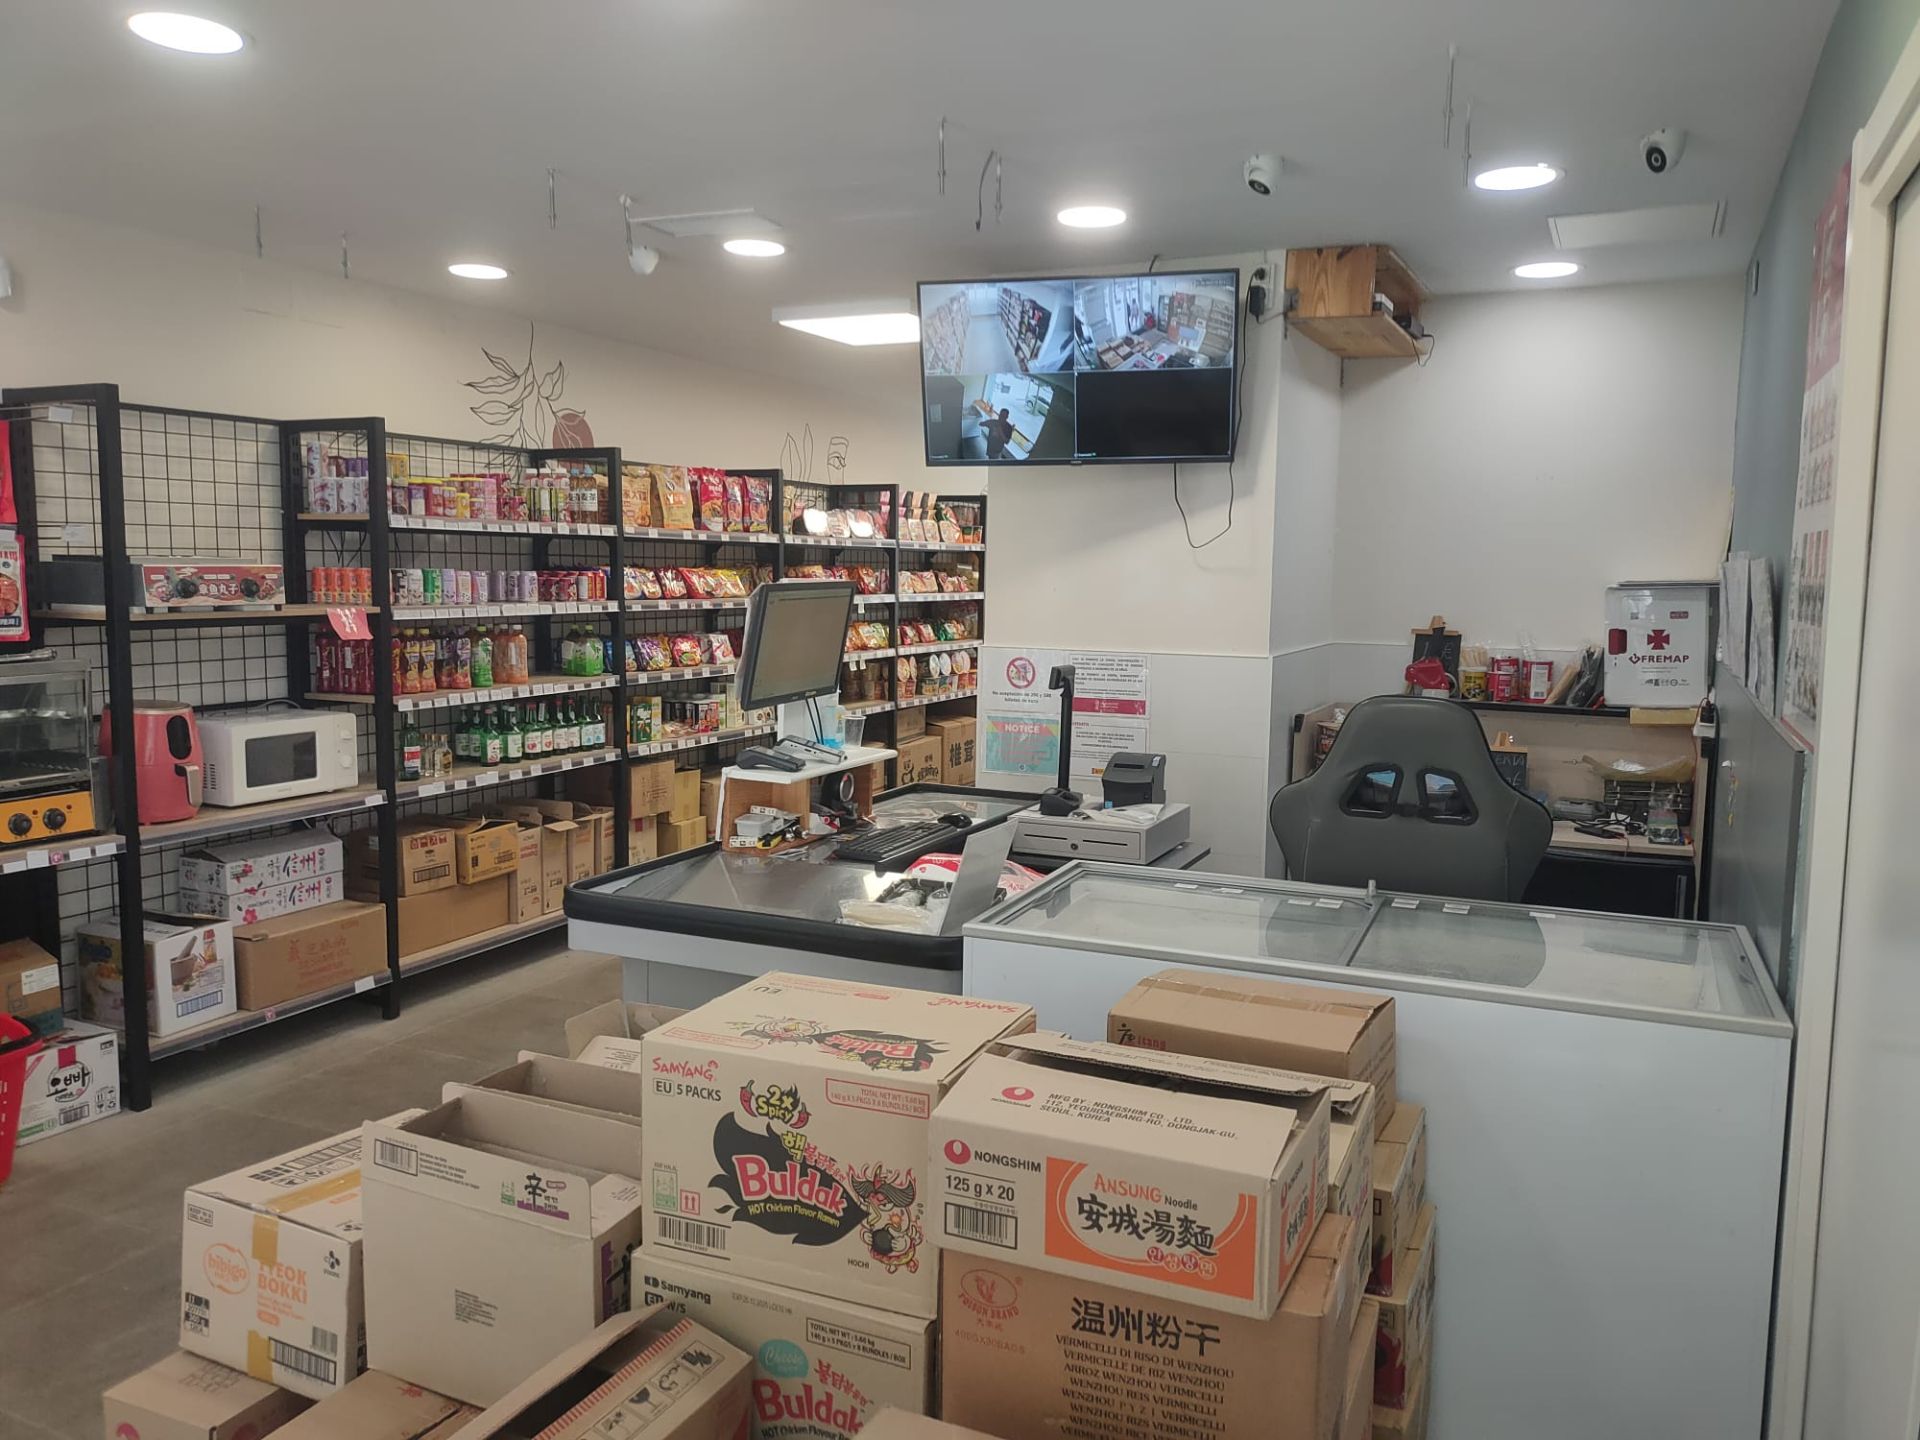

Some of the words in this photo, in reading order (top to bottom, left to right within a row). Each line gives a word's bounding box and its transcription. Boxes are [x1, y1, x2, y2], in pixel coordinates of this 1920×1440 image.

[1641, 655, 1690, 663] FREMAP
[1004, 723, 1041, 734] NOTICE
[46, 1065, 91, 1098] 오빠
[652, 1057, 719, 1082] SAMYANG
[655, 1081, 672, 1096] EU
[676, 1084, 684, 1098] 5
[685, 1085, 722, 1102] PACKS
[1048, 1092, 1071, 1103] MFG
[1093, 1101, 1149, 1117] NONGSHIM
[755, 1095, 794, 1125] Spicy
[1076, 1111, 1111, 1124] KOREA
[782, 1130, 807, 1163] 핵
[974, 1150, 1041, 1172] NONGSHIM
[731, 1154, 848, 1218] Buldak
[945, 1175, 970, 1194] 125
[974, 1182, 983, 1198] g
[996, 1185, 1015, 1202] 20
[1093, 1173, 1162, 1204] ANSUNG
[1164, 1194, 1198, 1211] Noodle
[748, 1203, 766, 1216] HOT
[766, 1203, 793, 1214] Chicken
[207, 1252, 248, 1284] bibigo
[847, 1259, 871, 1270] HOCHI
[257, 1273, 310, 1306] BOKKI
[660, 1281, 712, 1305] Samyang
[990, 1304, 1020, 1322] BRAND
[810, 1322, 828, 1333] TOTAL
[829, 1327, 841, 1337] NET
[867, 1337, 875, 1348] kg
[1070, 1296, 1221, 1357] 温州粉干
[836, 1338, 851, 1349] PKGS
[862, 1345, 889, 1360] BUNDLES
[894, 1353, 906, 1364] BOX
[1056, 1334, 1117, 1356] VERMICELLI
[1119, 1346, 1131, 1359] DI
[1133, 1349, 1160, 1365] RISO
[1162, 1356, 1174, 1368] DI
[1176, 1358, 1235, 1380] WENZHOU
[1063, 1349, 1129, 1372] VERMICELLE
[1130, 1362, 1146, 1376] DE
[1148, 1367, 1165, 1380] RIZ
[1167, 1370, 1225, 1392] WENZHOU
[1063, 1363, 1101, 1380] ARROZ
[1102, 1370, 1158, 1391] WENZHOU
[1159, 1382, 1225, 1405] VERMICELLI
[1069, 1376, 1124, 1398] WENZHOU
[1125, 1389, 1151, 1403] REIS
[1152, 1395, 1218, 1418] VERMICELLI
[750, 1378, 864, 1434] Buldak
[1060, 1387, 1116, 1409] WENZHOU
[1160, 1409, 1227, 1433] VERMICELLI
[1069, 1401, 1124, 1422] WENZHOU
[761, 1425, 780, 1440] HOT
[781, 1425, 808, 1435] Chicken
[808, 1425, 839, 1439] Flavour
[1068, 1415, 1123, 1435] WENZHOU
